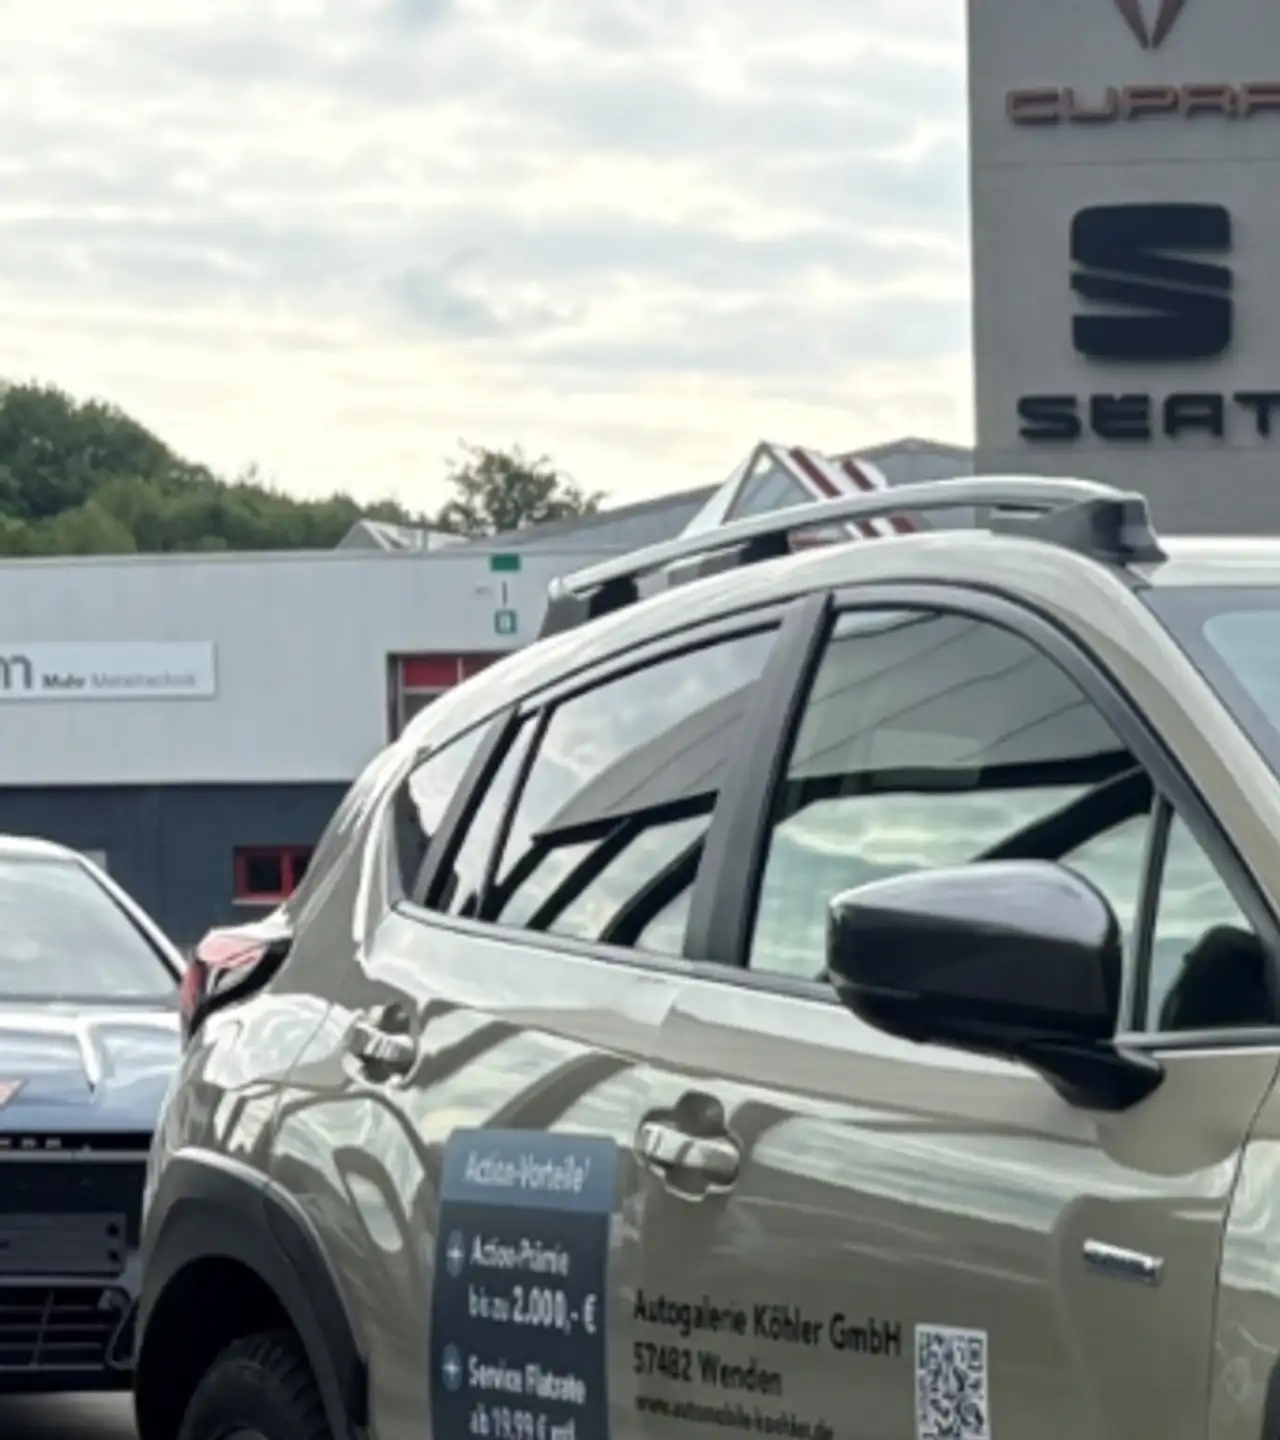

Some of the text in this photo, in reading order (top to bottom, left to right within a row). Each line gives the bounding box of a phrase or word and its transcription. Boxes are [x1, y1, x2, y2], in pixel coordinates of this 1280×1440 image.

[633, 1287, 902, 1357] Autogalerie Köhler GmbH
[468, 1353, 587, 1406] Service Flatrate
[633, 1340, 783, 1398] 57482 Wenden
